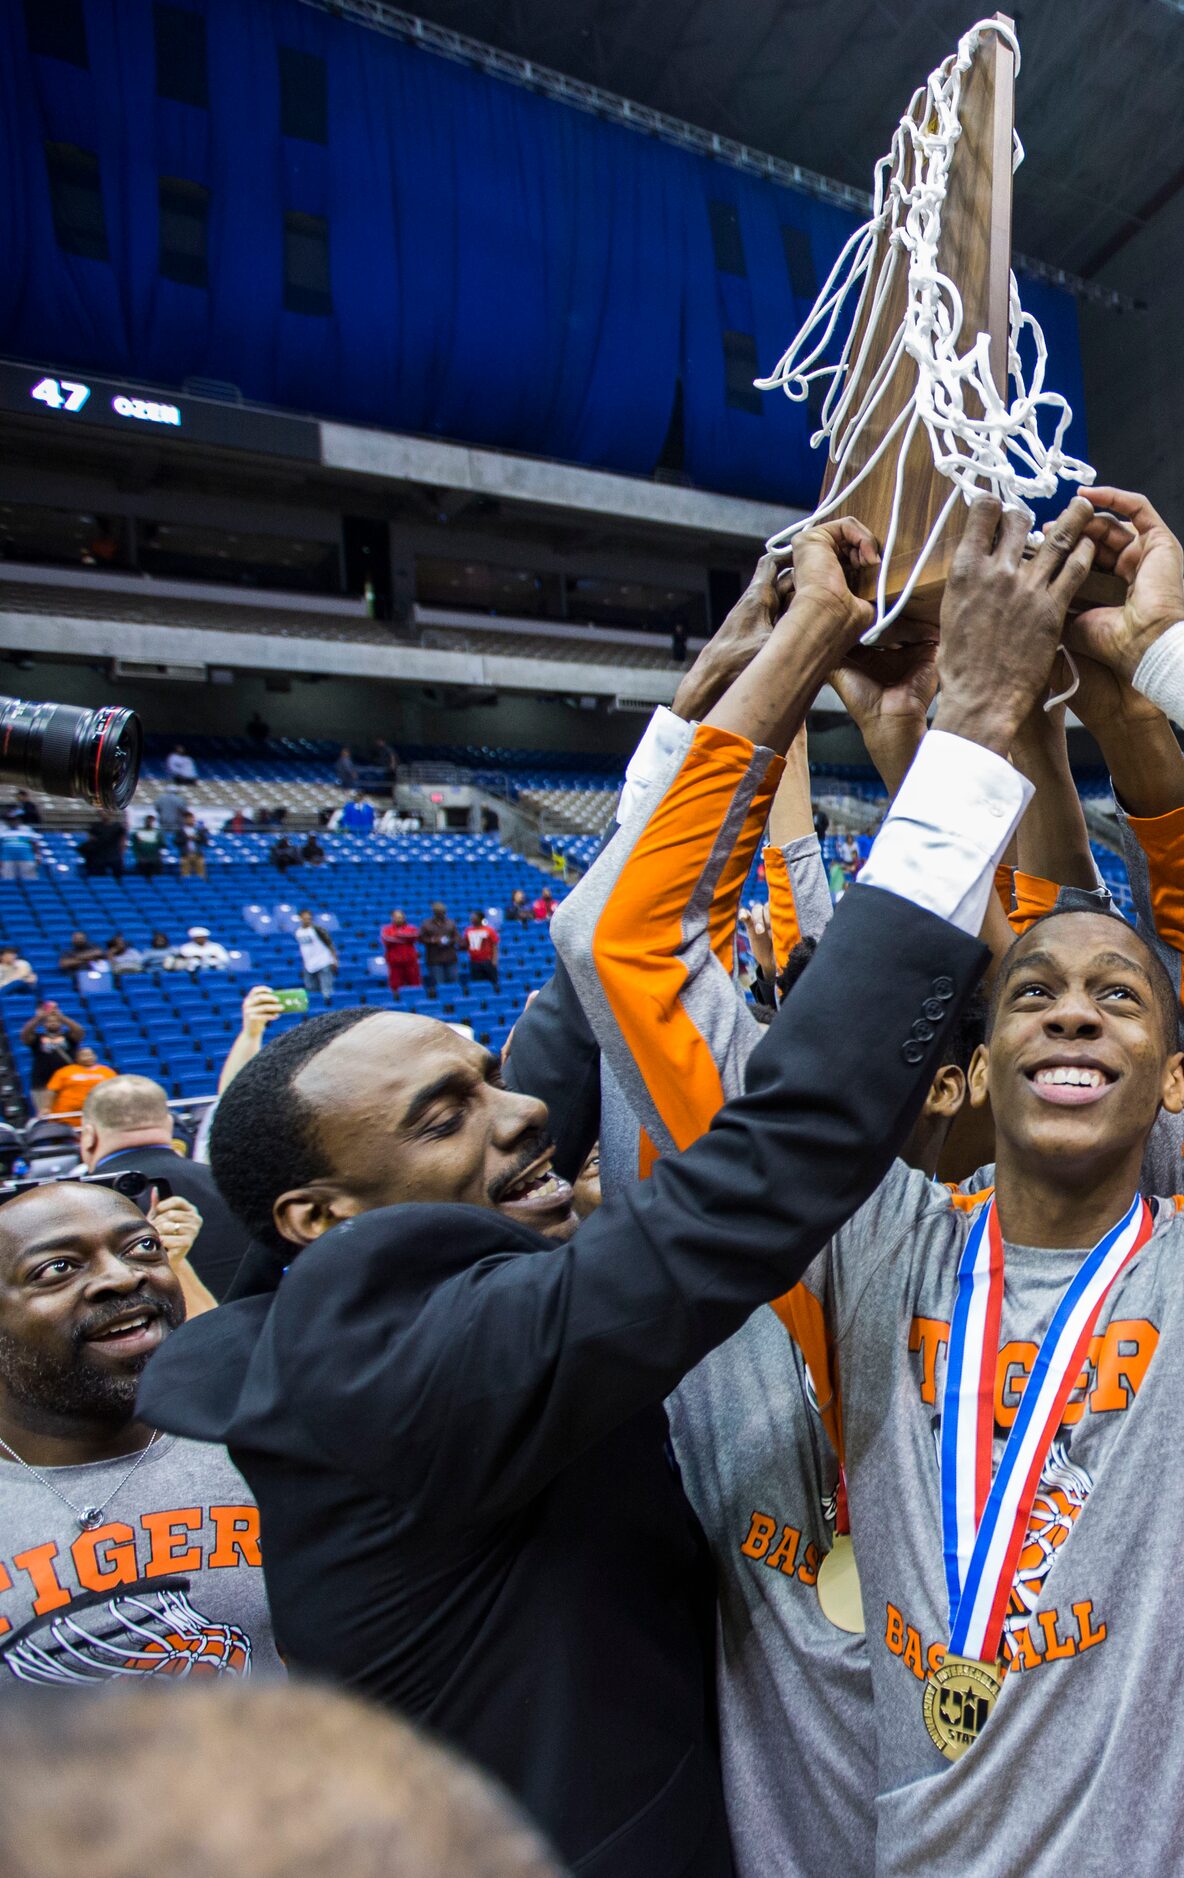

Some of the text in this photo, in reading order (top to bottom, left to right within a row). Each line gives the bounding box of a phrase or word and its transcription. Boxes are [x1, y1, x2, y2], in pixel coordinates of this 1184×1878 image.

[31, 376, 92, 413] 47
[908, 1316, 1161, 1428] TGER
[947, 1728, 979, 1745] STAT
